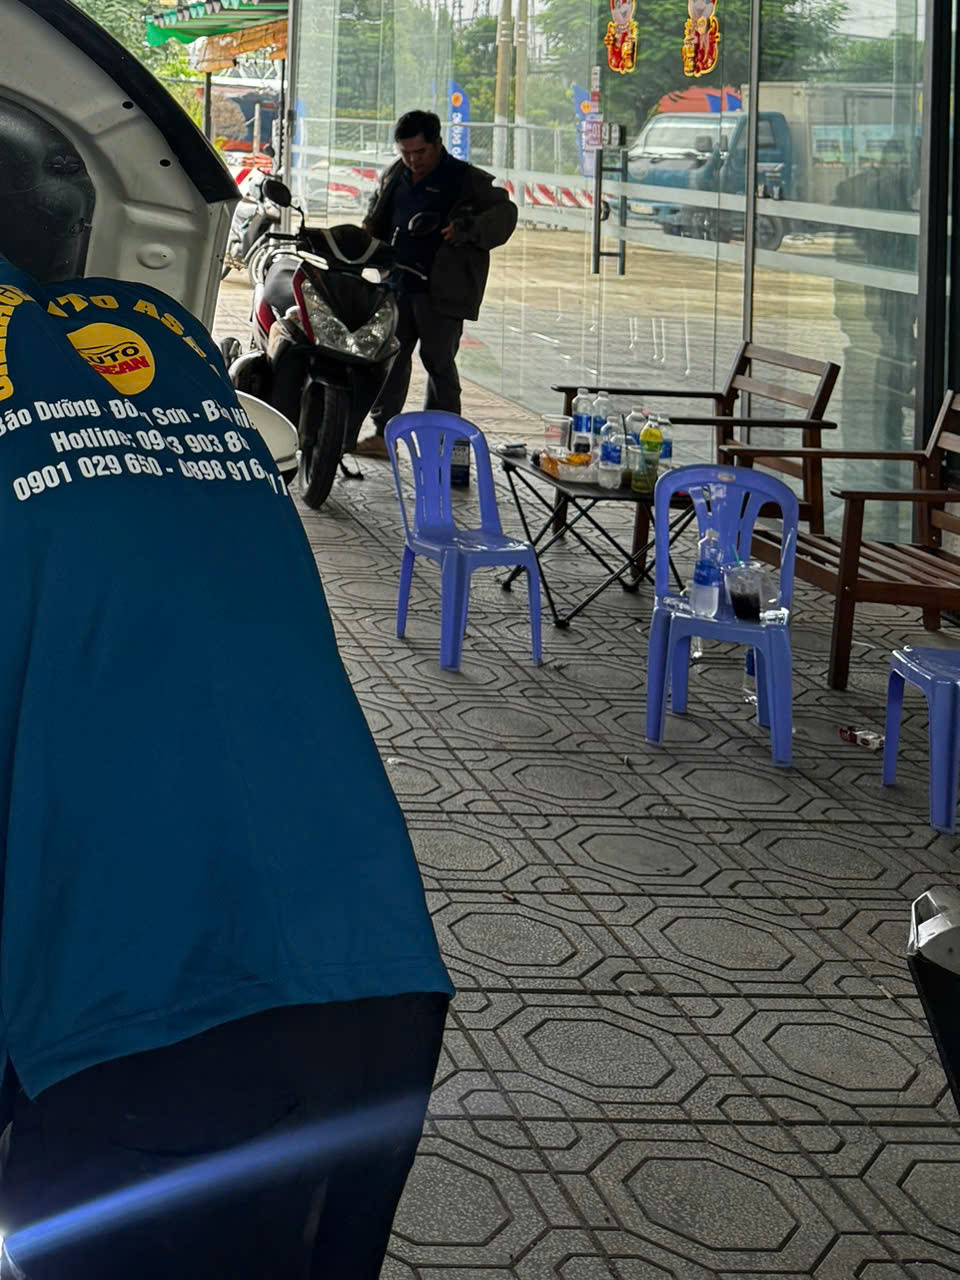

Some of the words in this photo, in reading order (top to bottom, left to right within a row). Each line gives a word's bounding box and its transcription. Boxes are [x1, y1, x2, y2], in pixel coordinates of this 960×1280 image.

[33, 399, 101, 421] Dưỡng
[152, 407, 192, 426] Sơn
[50, 427, 137, 453] Hotline:
[184, 433, 224, 454] 903
[13, 461, 73, 501] 0901
[77, 454, 123, 478] 029
[124, 453, 163, 477] 650
